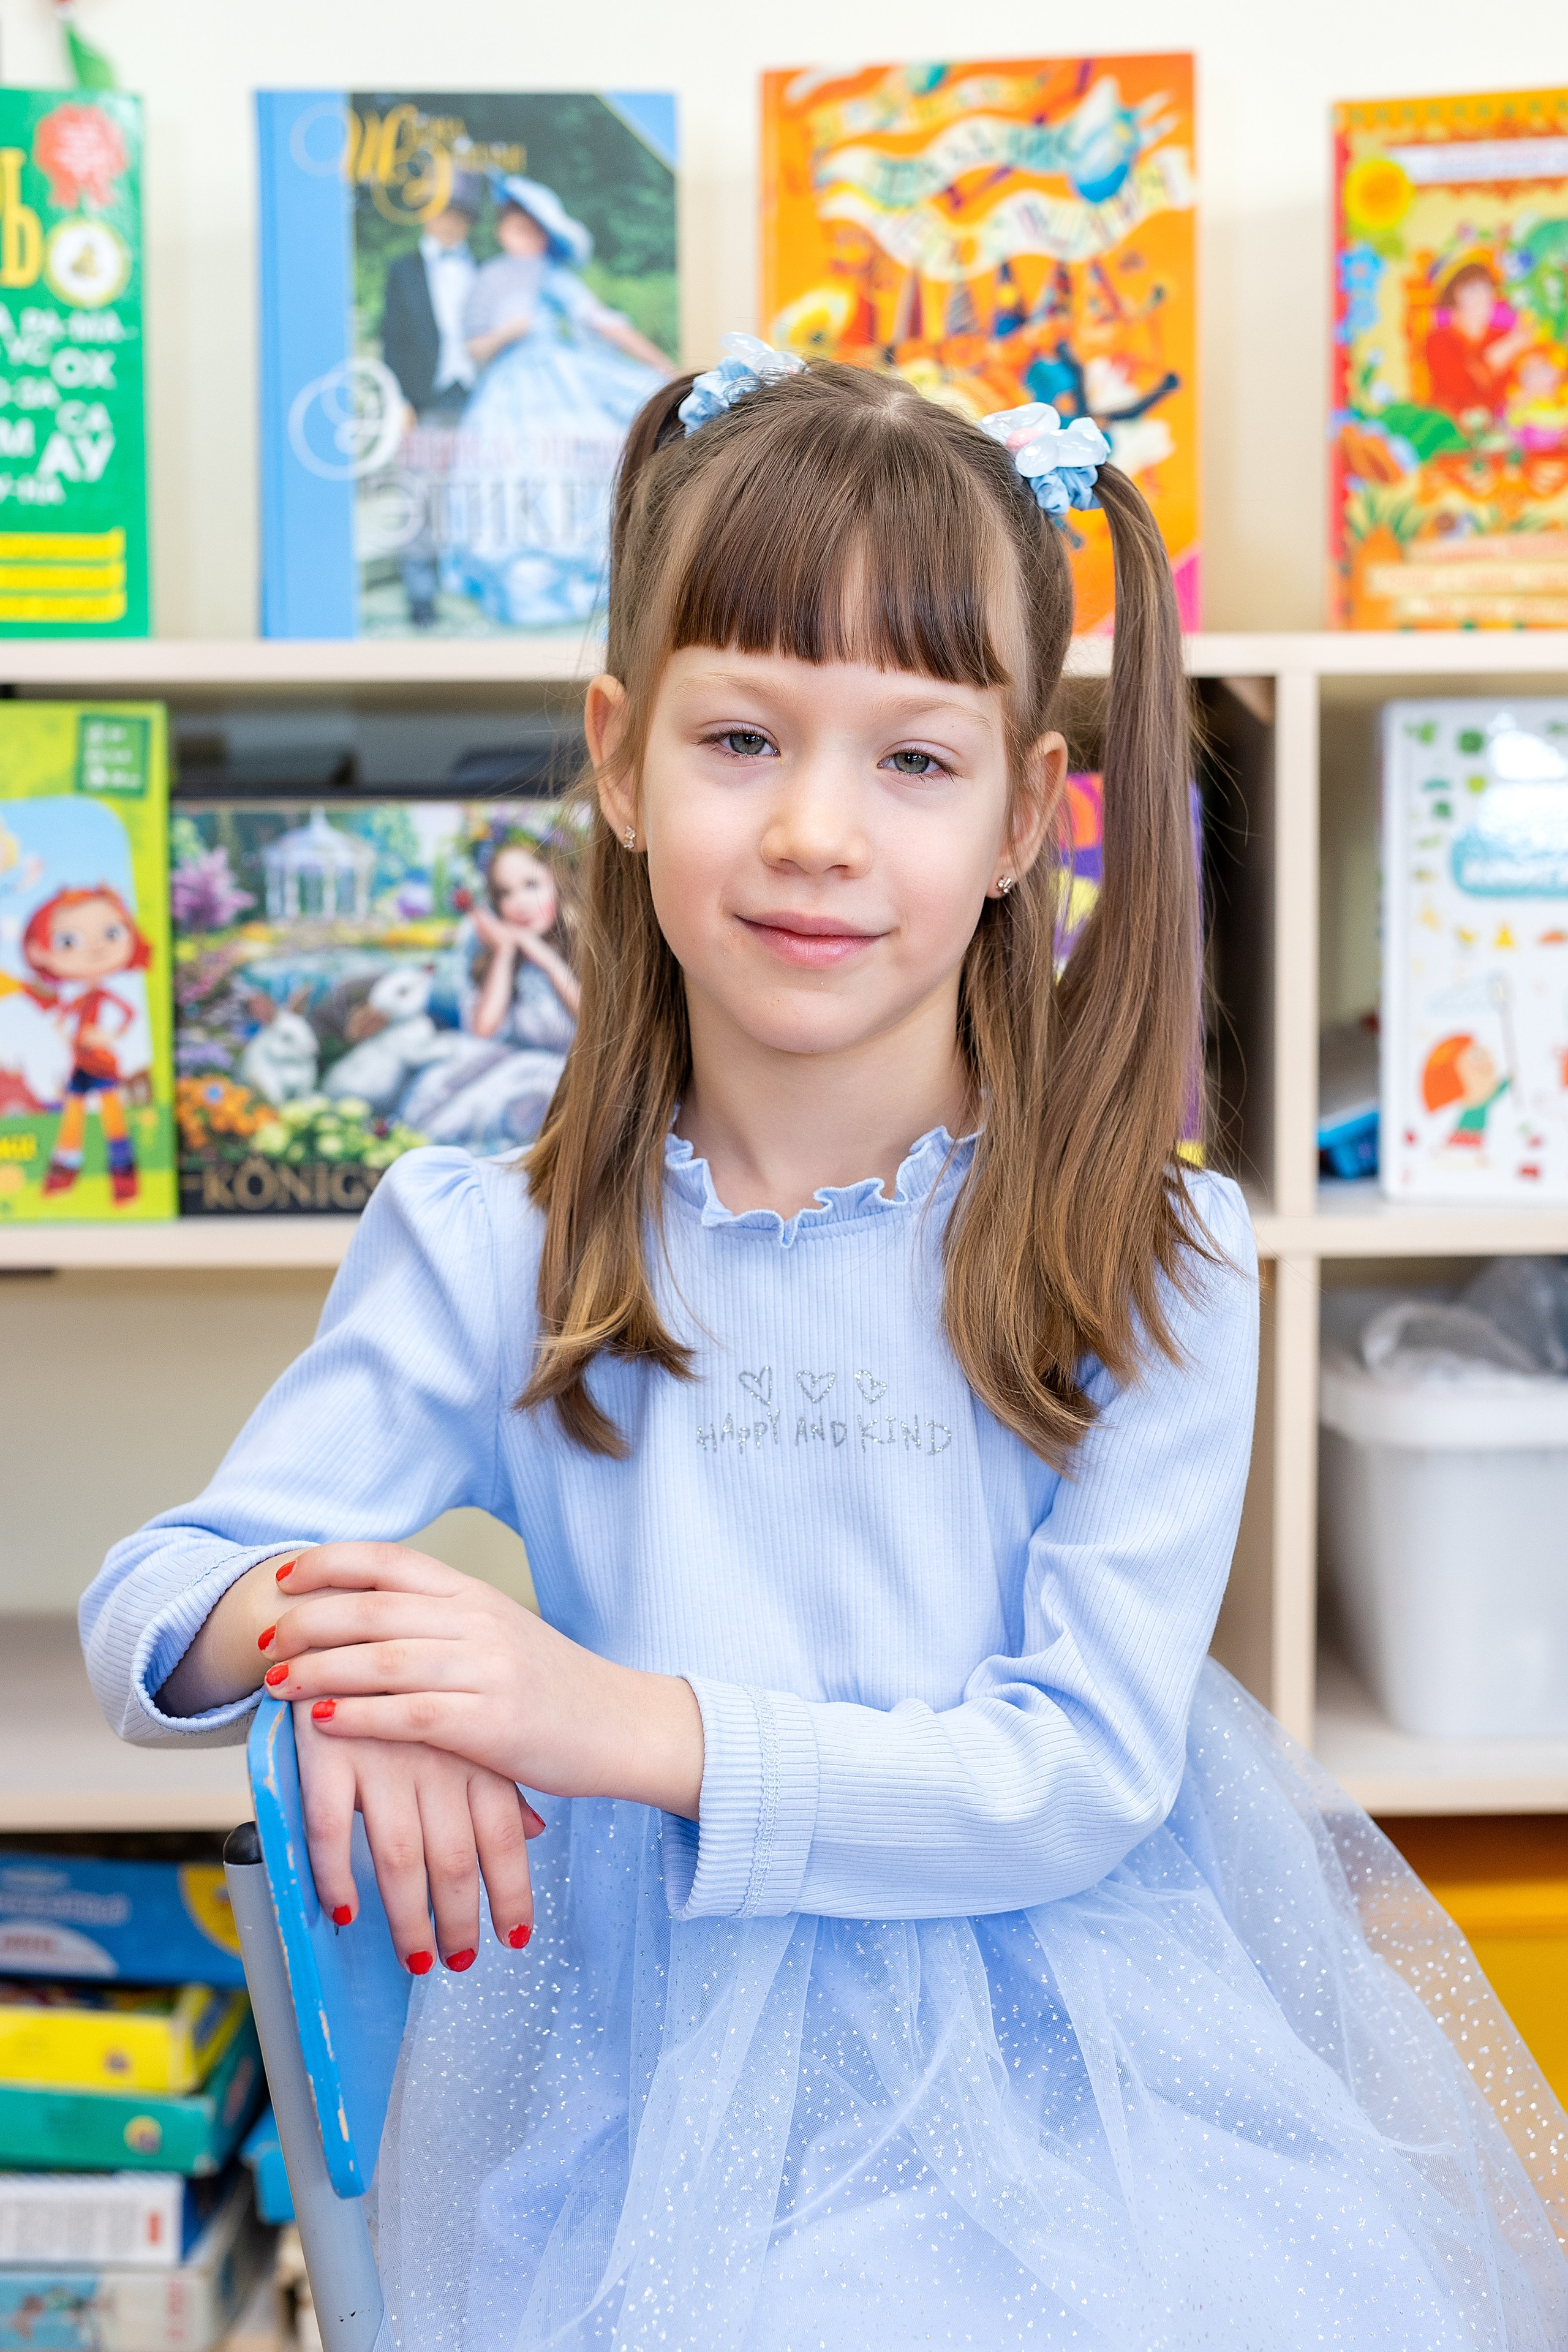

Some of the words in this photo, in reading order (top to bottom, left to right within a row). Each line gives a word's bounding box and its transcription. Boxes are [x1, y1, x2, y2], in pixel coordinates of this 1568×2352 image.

[696, 1409, 780, 1453] HAPPY
[795, 1415, 847, 1447] AND
[857, 1414, 952, 1456] KIND
